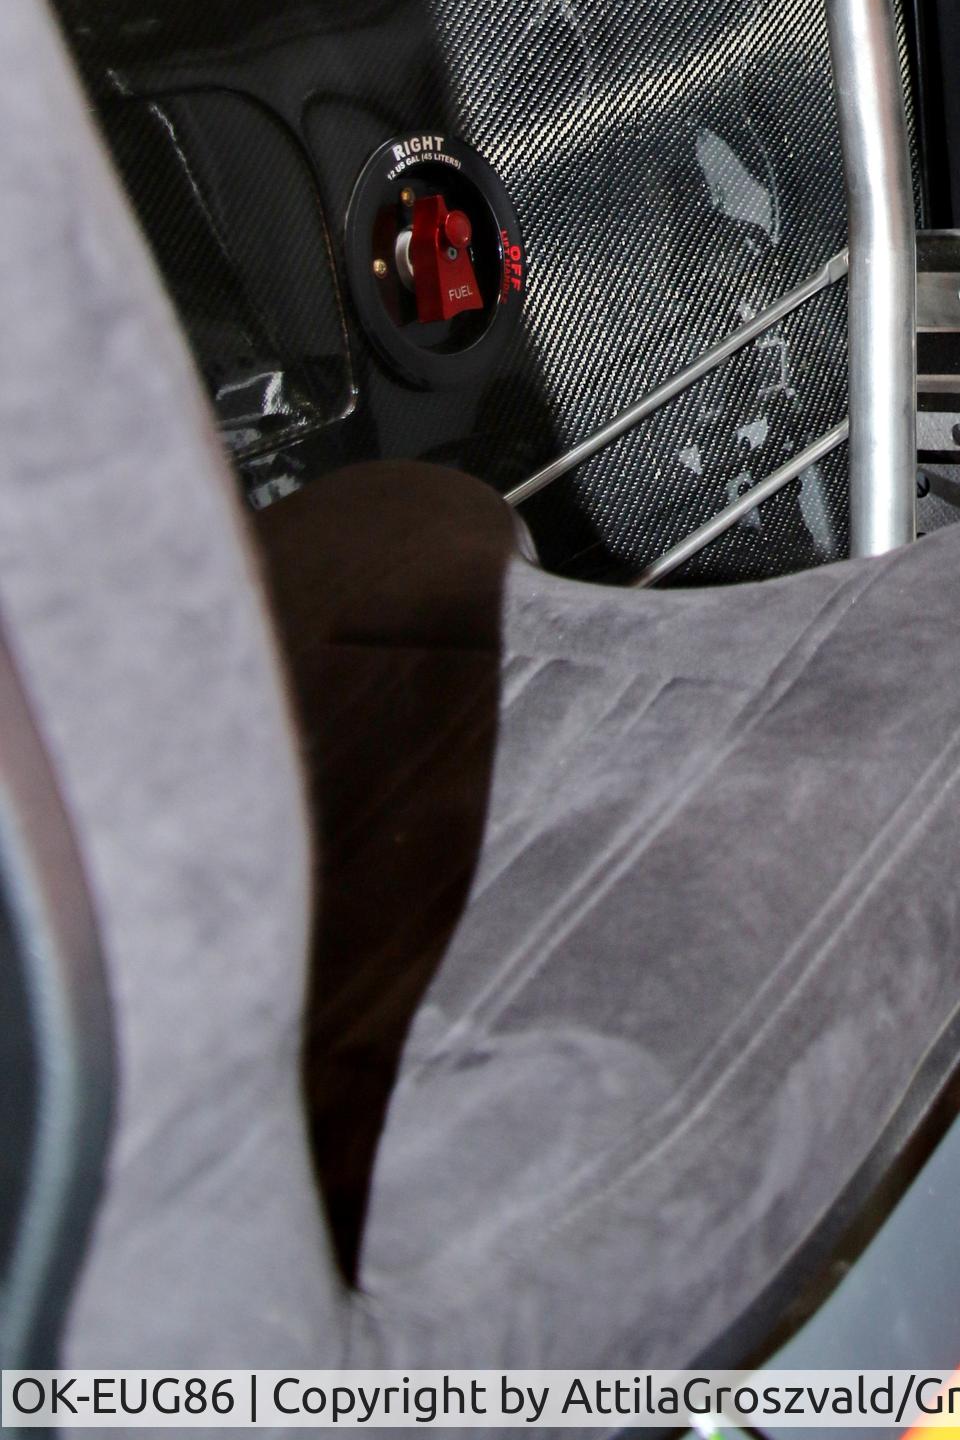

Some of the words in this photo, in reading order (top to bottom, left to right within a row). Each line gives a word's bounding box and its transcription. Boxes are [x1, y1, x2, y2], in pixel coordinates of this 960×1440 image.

[392, 135, 445, 161] RIGHT
[395, 161, 406, 173] US
[406, 155, 420, 166] GAL
[510, 245, 522, 291] OFF
[448, 285, 474, 301] FUEL
